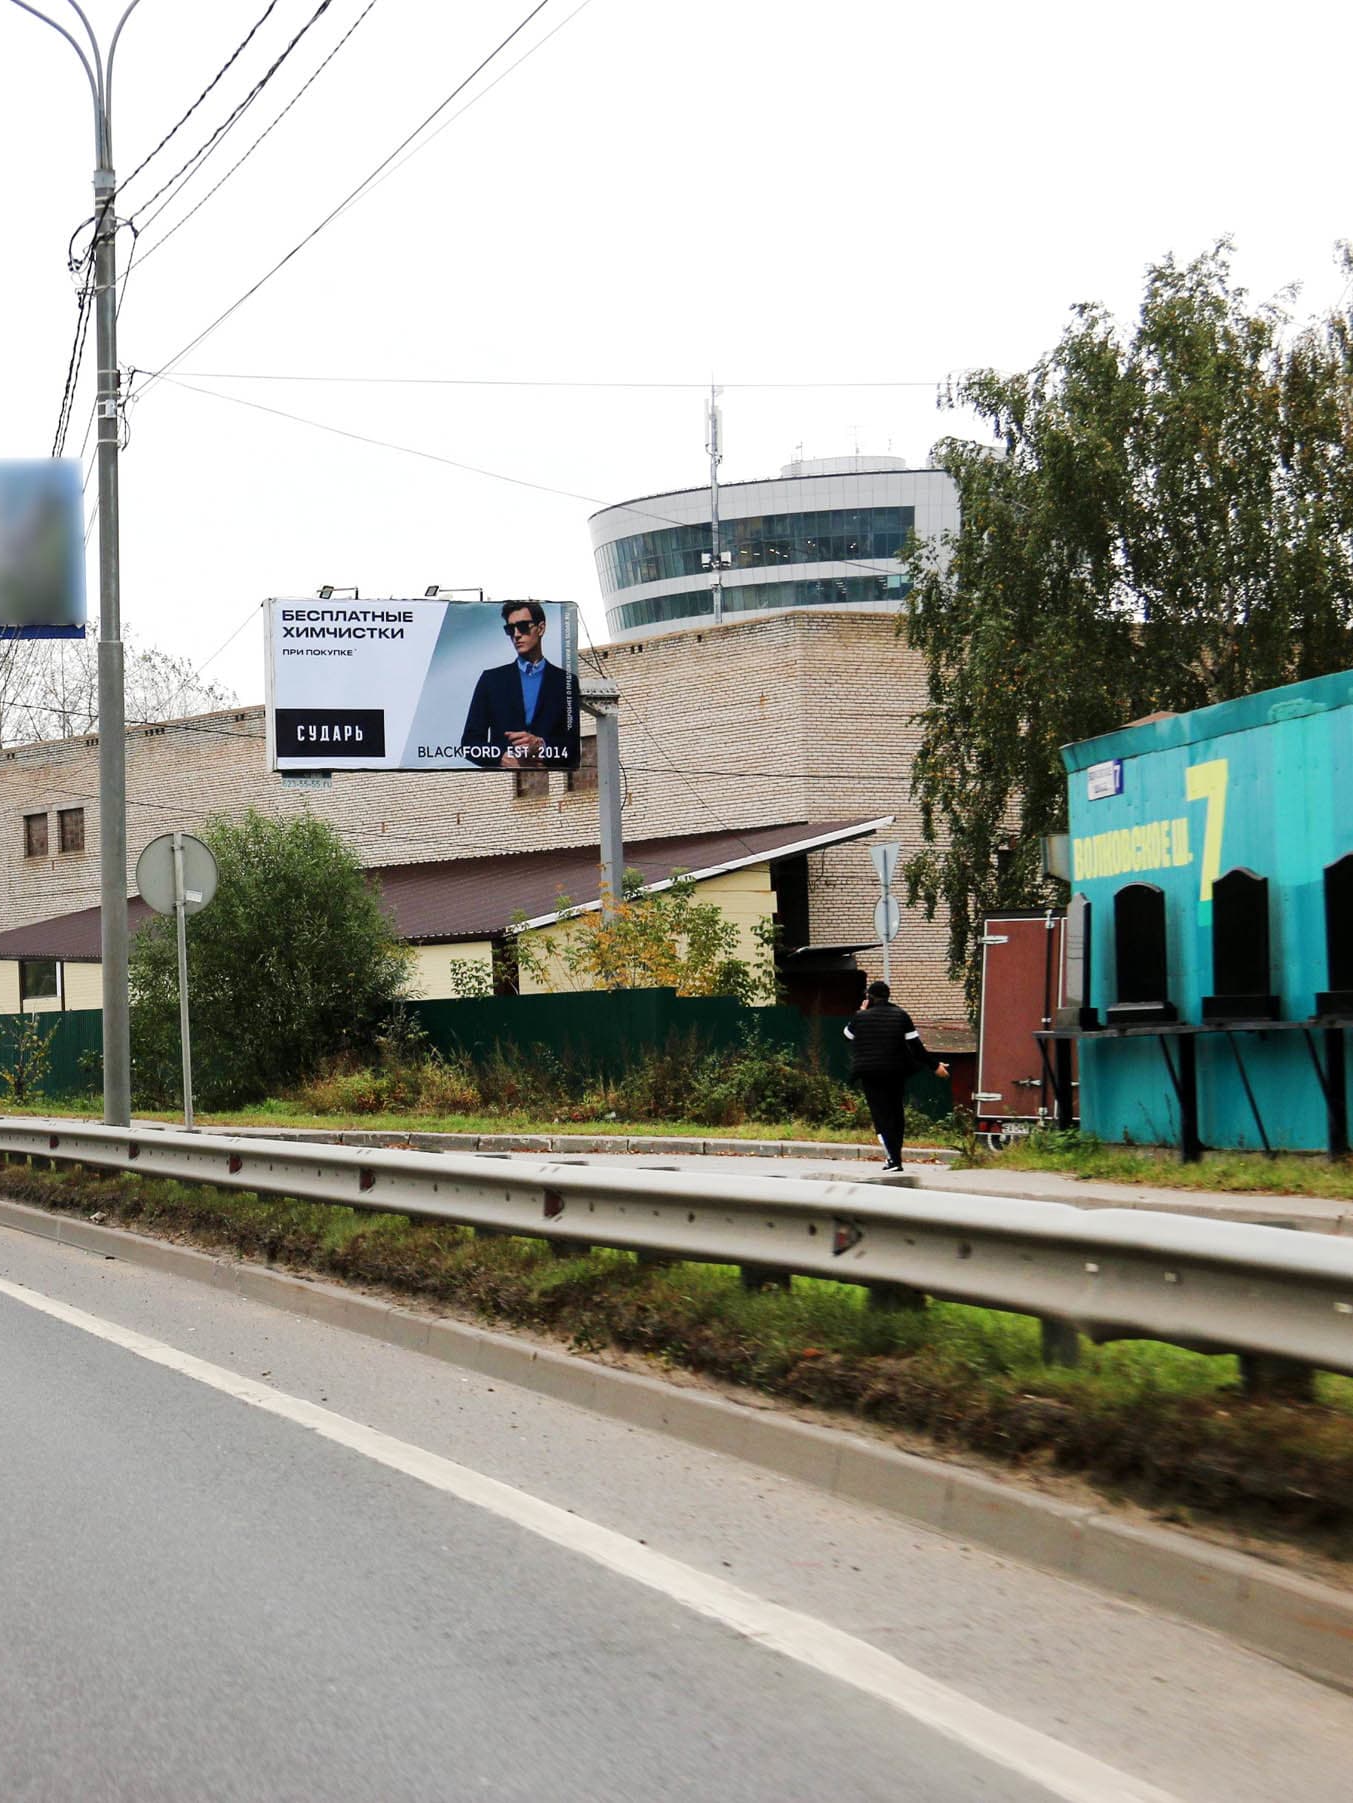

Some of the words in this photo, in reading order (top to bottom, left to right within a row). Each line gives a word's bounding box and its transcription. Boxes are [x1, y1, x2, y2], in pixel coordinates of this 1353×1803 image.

[282, 610, 413, 622] БЕСПЛАТНЫЕ
[282, 626, 404, 639] ХИМЧИСТКИ
[297, 725, 364, 742] СУДАРЬ
[418, 746, 501, 758] BLACKFORD
[1185, 758, 1229, 902] 7
